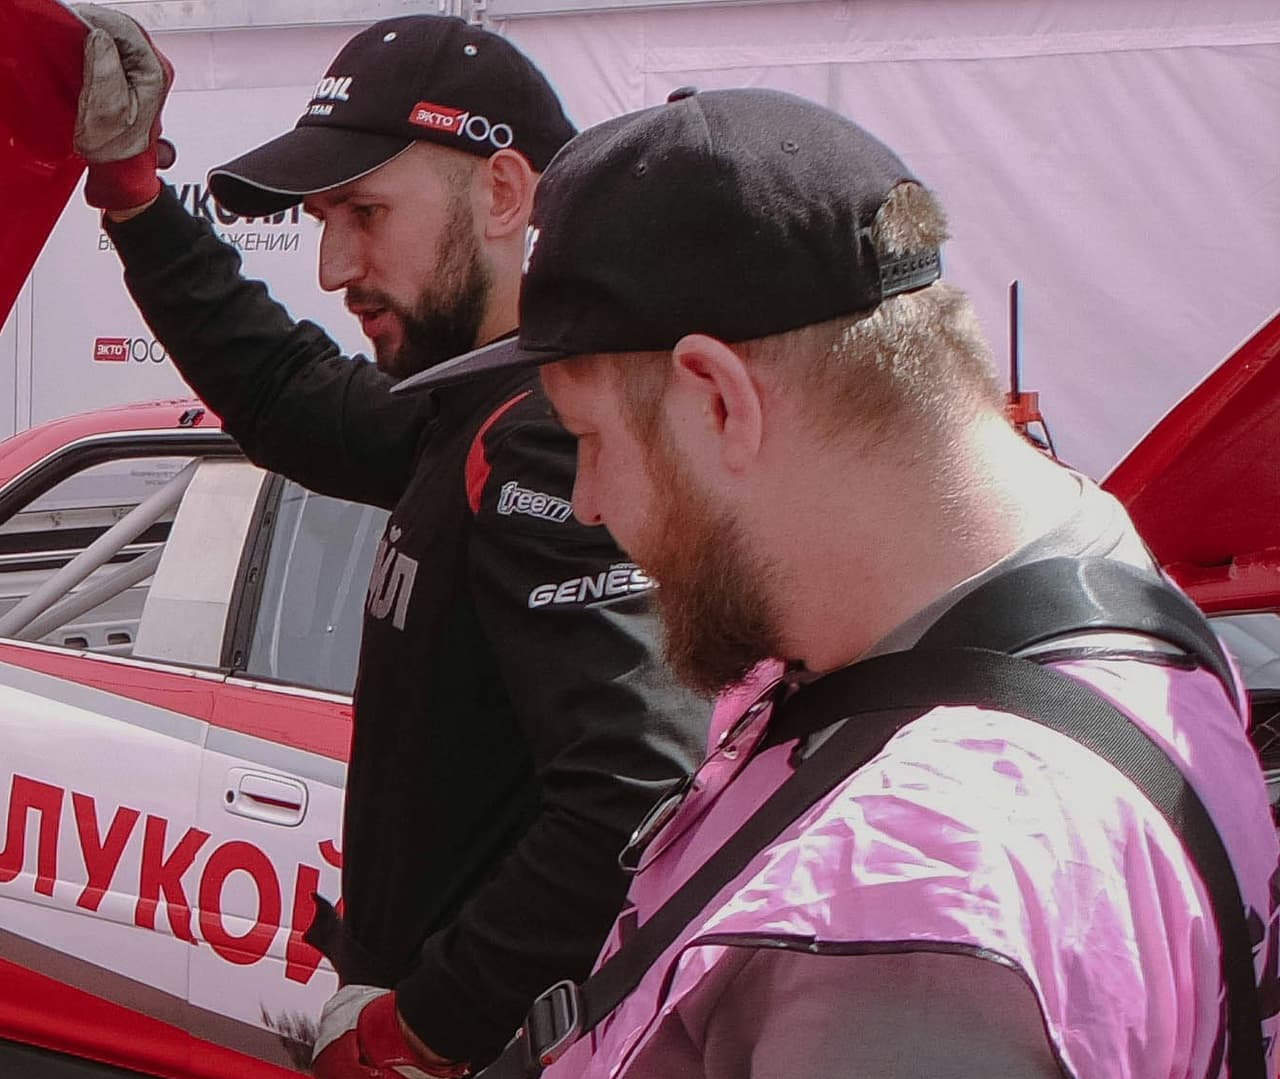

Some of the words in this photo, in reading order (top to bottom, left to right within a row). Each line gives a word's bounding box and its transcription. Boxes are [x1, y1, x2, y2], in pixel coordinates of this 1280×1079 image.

[416, 109, 454, 127] ЭКТО
[456, 111, 513, 149] 100
[497, 481, 574, 523] freem
[528, 568, 654, 608] GENES
